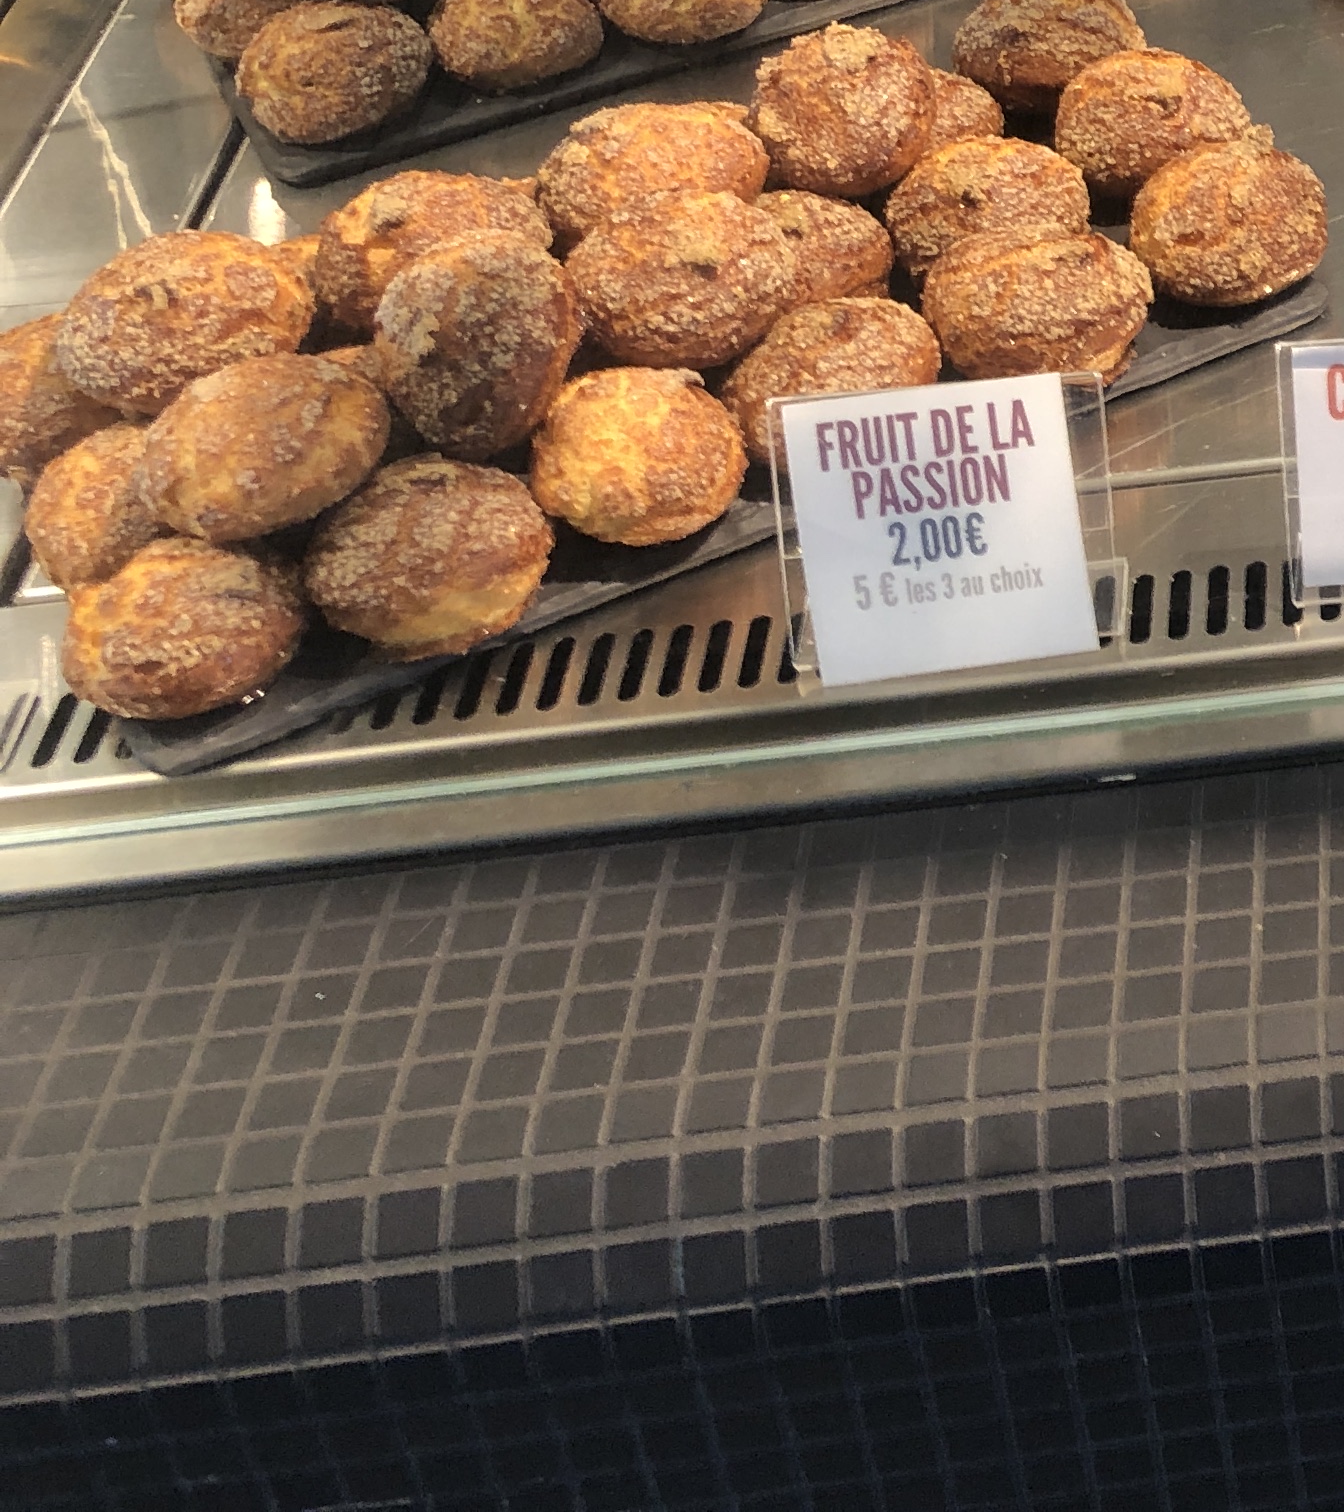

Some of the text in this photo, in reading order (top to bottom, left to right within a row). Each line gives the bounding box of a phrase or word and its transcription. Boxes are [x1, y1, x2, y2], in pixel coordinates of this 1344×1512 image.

[816, 399, 1035, 472] FRUIT DE LA
[852, 453, 1011, 519] PASSION
[888, 512, 989, 571] 2,00€
[853, 563, 1044, 610] 5 € les 3 au choix
